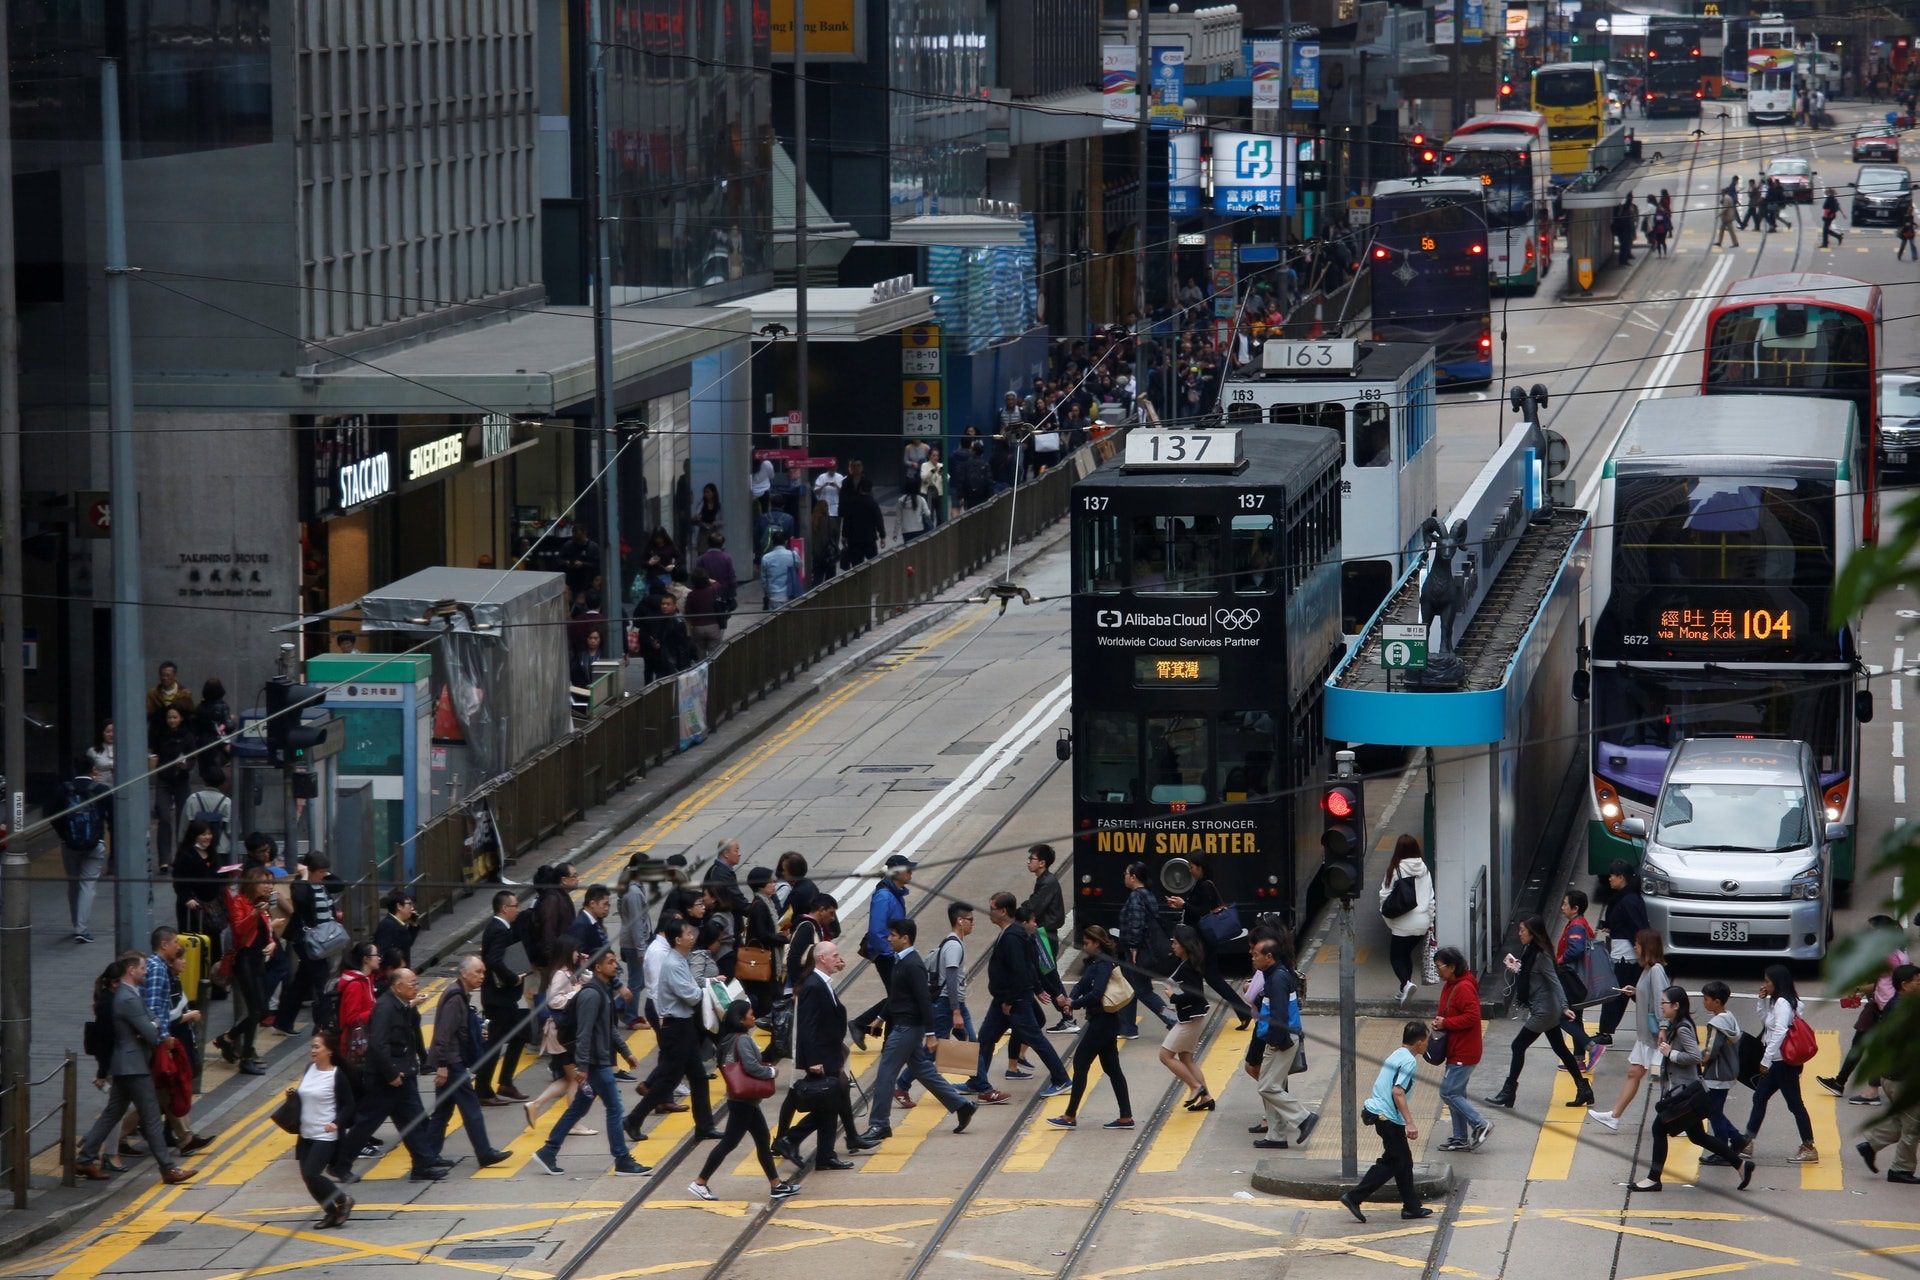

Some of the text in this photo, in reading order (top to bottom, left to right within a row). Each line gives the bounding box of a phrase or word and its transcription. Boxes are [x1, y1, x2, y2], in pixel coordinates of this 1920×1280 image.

[819, 21, 849, 32] Bank
[1226, 190, 1281, 202] 富邦銀行
[1287, 346, 1332, 366] 163
[1232, 390, 1254, 400] 163
[1358, 389, 1381, 400] 163
[917, 413, 938, 421] 8-10
[1150, 435, 1212, 461] 137
[409, 433, 463, 481] SKECHERS
[340, 451, 390, 508] STACCATO
[1083, 496, 1109, 510] 137
[1238, 494, 1265, 508] 137
[234, 553, 270, 563] HOUSE
[1125, 613, 1207, 626] Alibaba Cloud
[1744, 609, 1792, 640] 104
[1658, 626, 1736, 641] via Mong Kok
[1097, 636, 1260, 647] Worldwide Cloud Services Partner
[1623, 635, 1649, 645] 5672
[1171, 803, 1187, 811] 122
[1097, 818, 1258, 830] FASTER. HIGHER. STRONGER.
[1097, 831, 1261, 854] NOW SMARTER.
[1721, 921, 1738, 931] SR
[1712, 930, 1746, 941] 5933
